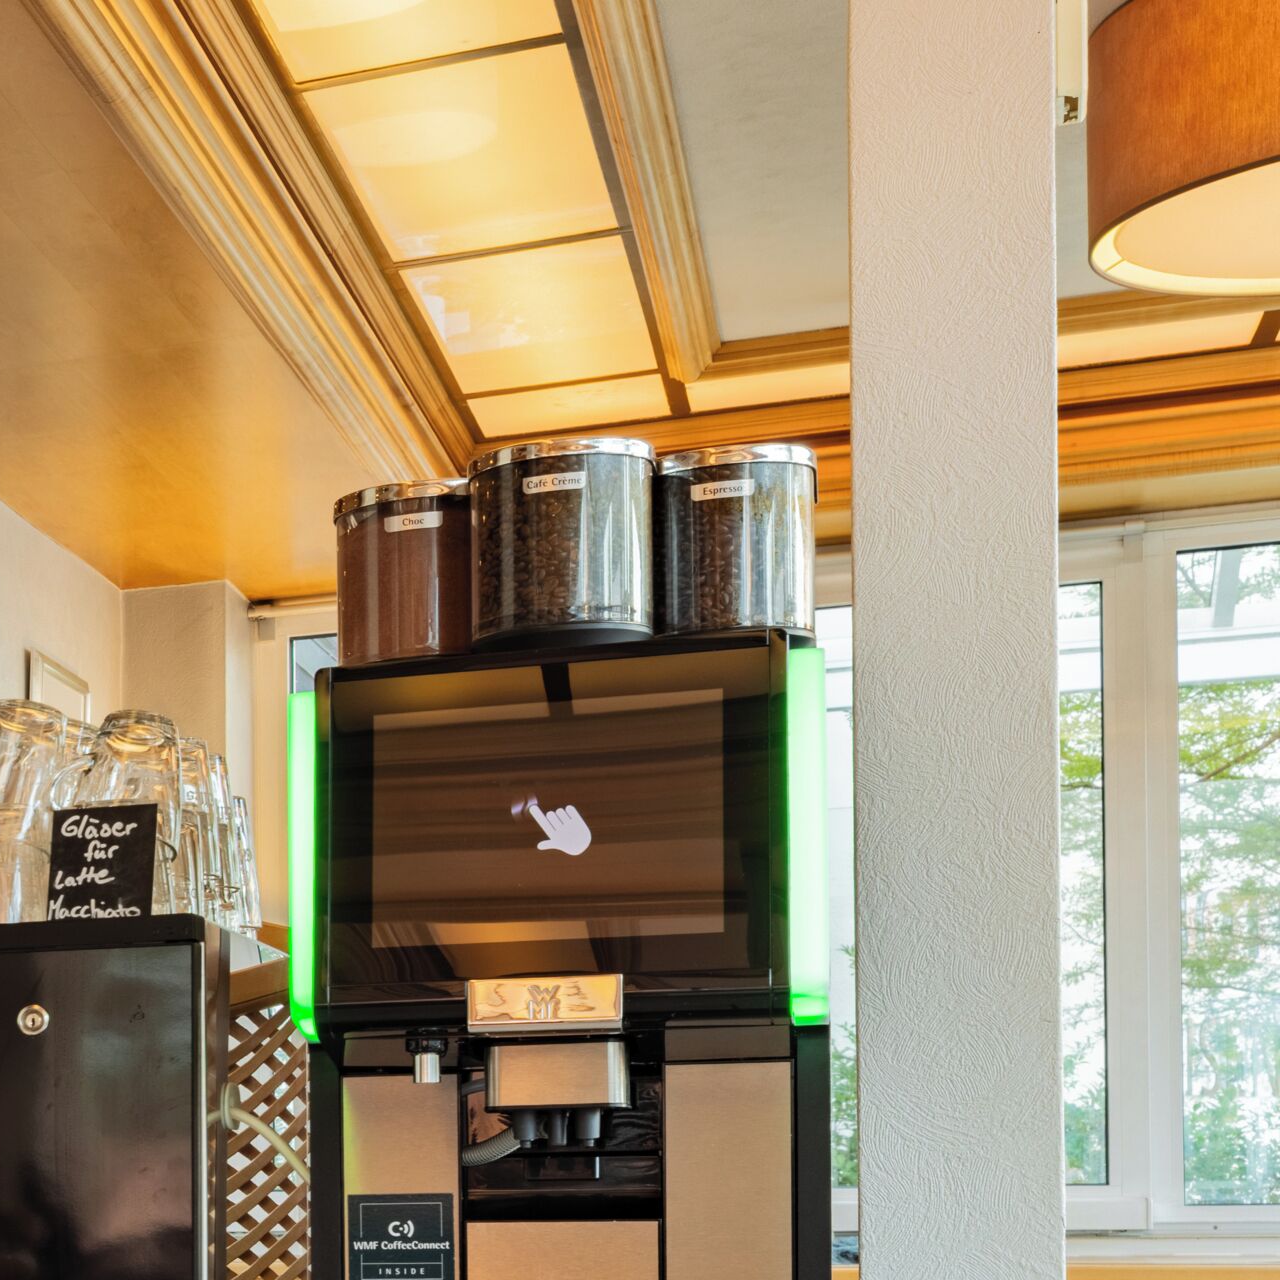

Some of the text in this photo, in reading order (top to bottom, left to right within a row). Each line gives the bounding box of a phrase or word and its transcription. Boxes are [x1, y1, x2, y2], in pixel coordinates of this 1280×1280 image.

[526, 476, 583, 490] Café Crème
[703, 486, 743, 496] Espresso
[402, 517, 425, 527] Choc
[60, 814, 138, 839] Gläser
[83, 840, 120, 863] für
[53, 866, 116, 890] Latte
[47, 894, 141, 921] Macchiato
[353, 1240, 451, 1251] WMF CoffeeConnect
[378, 1267, 425, 1276] INSIDE
